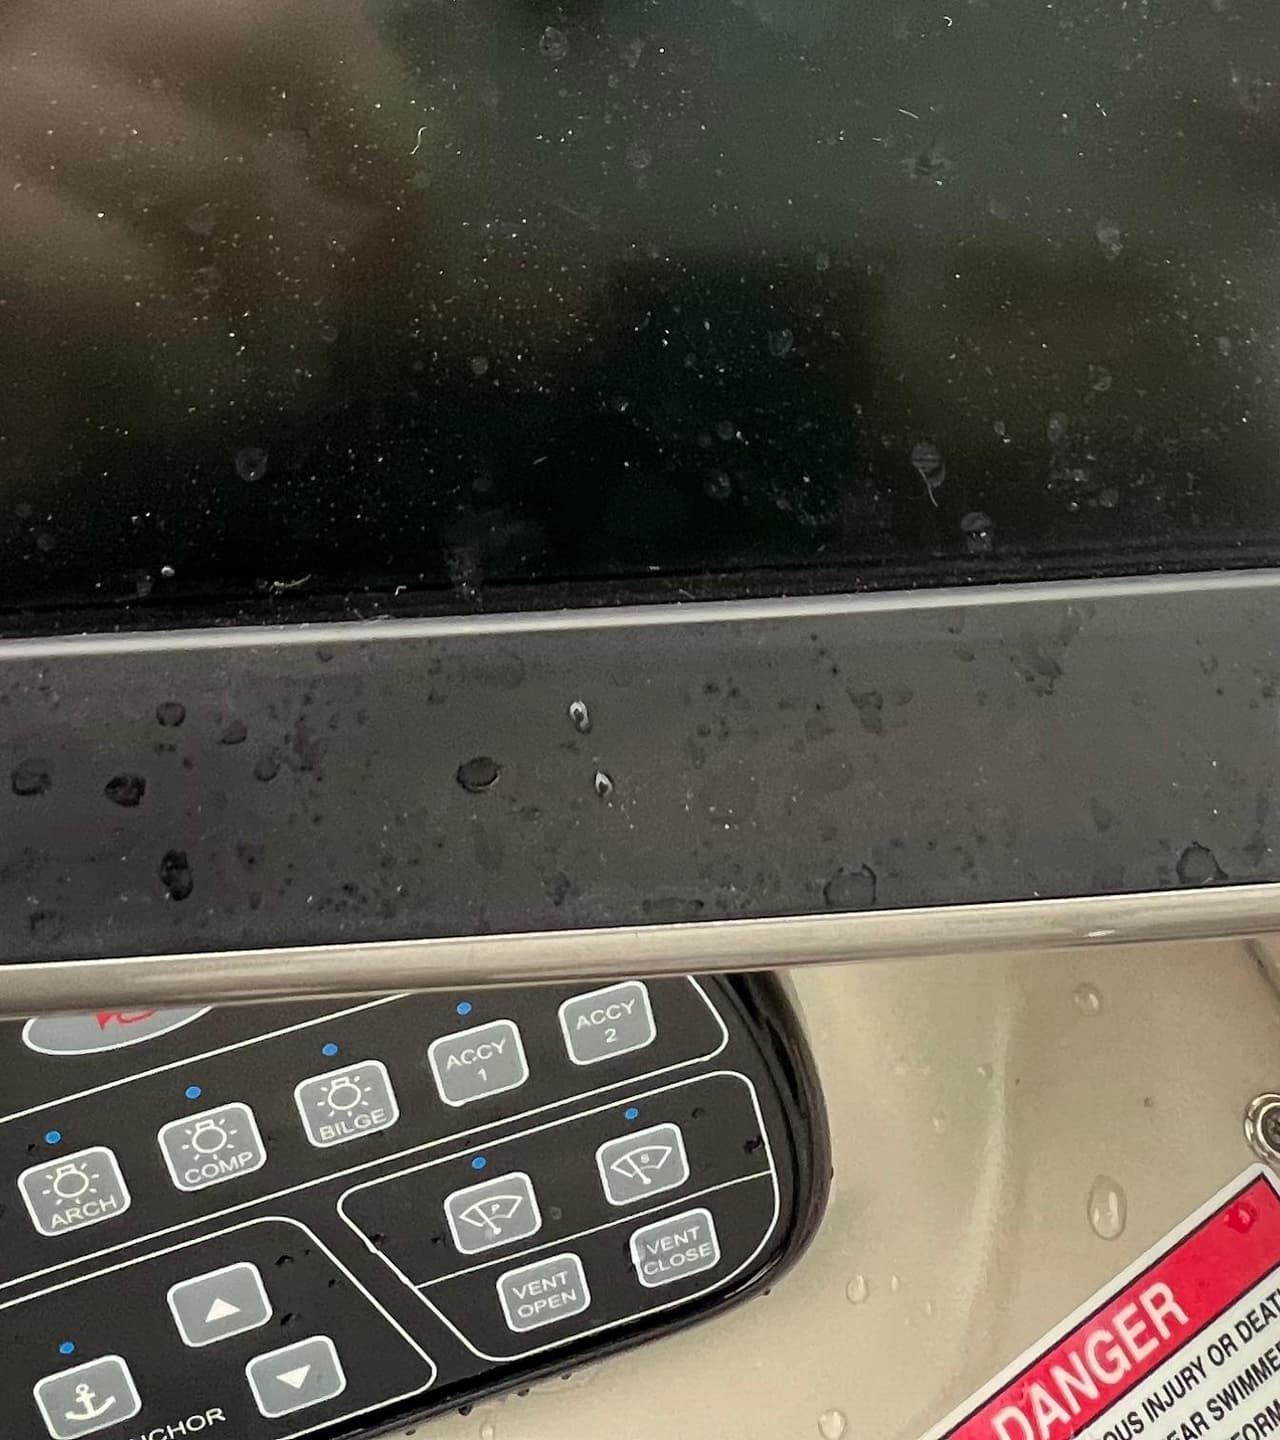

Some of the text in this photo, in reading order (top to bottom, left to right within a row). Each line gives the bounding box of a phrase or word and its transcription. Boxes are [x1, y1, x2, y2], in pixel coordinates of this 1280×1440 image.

[576, 998, 636, 1031] ACCY
[604, 1028, 618, 1043] 2
[446, 1037, 506, 1071] ACCY
[476, 1068, 488, 1082] 1
[319, 1109, 388, 1142] BILGE
[184, 1151, 253, 1185] COMP
[51, 1195, 118, 1229] ARCH
[490, 1203, 501, 1215] P
[645, 1226, 701, 1255] VENT
[643, 1242, 714, 1276] CLOSE
[511, 1270, 569, 1300] VENT
[517, 1289, 578, 1319] OPEN
[991, 1282, 1190, 1440] DANGER
[1141, 1356, 1208, 1423] INJURY
[1206, 1333, 1240, 1367] OR
